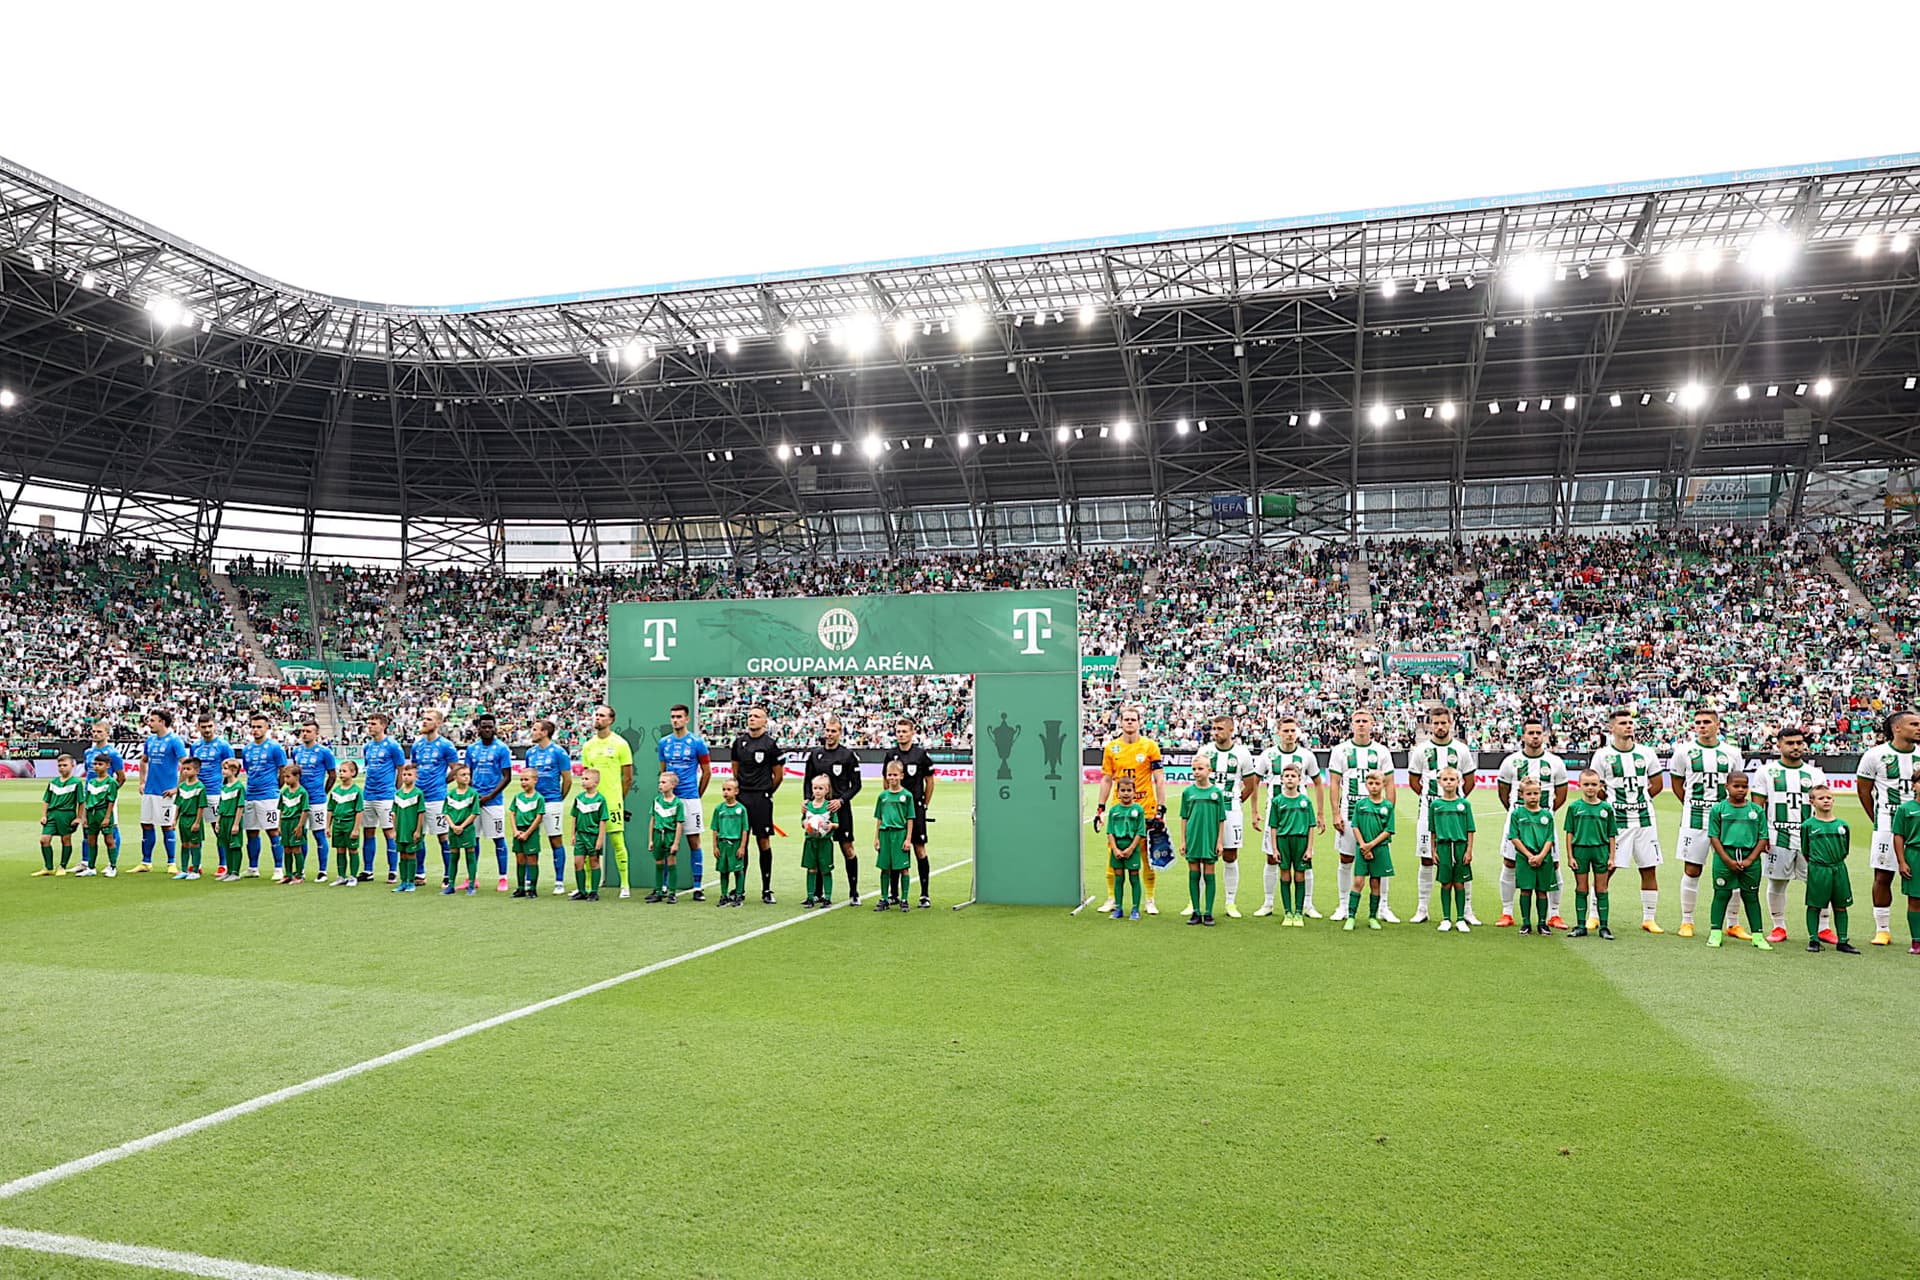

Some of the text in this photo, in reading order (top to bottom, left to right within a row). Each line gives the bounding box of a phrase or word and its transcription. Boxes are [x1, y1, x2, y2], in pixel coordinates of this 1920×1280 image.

[1213, 502, 1243, 512] UEFA
[747, 651, 934, 673] GROUPAMA ARÉNA
[933, 768, 965, 776] FAST
[999, 785, 1011, 800] 6
[1049, 786, 1057, 801] 1
[164, 808, 170, 818] 4
[266, 811, 278, 823] 20
[314, 812, 325, 823] 32
[610, 811, 622, 823] 31
[494, 820, 503, 832] 10
